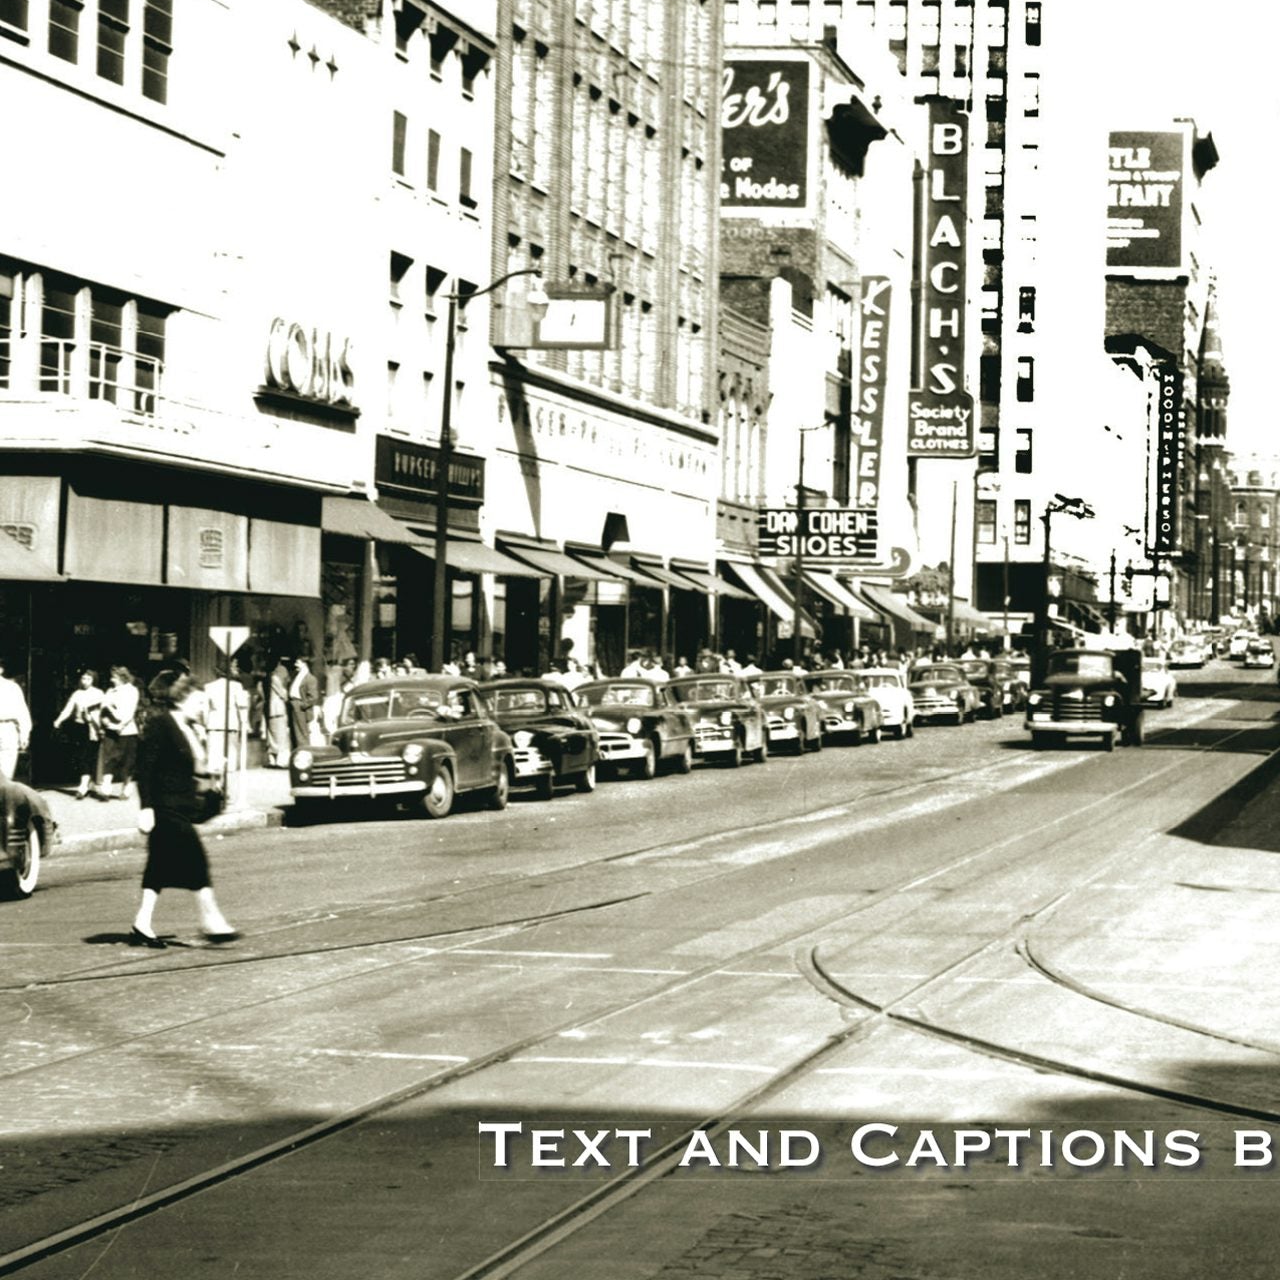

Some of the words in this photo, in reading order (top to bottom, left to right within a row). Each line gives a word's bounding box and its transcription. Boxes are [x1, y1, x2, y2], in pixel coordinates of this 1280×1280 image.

[930, 122, 963, 395] BLACH'S
[858, 279, 892, 506] KESSLER
[909, 402, 971, 422] Society
[915, 420, 967, 437] Brand
[910, 438, 969, 451] CLOTHES
[767, 511, 798, 533] DAN
[809, 512, 868, 534] COHEN
[777, 535, 857, 556] SHOES
